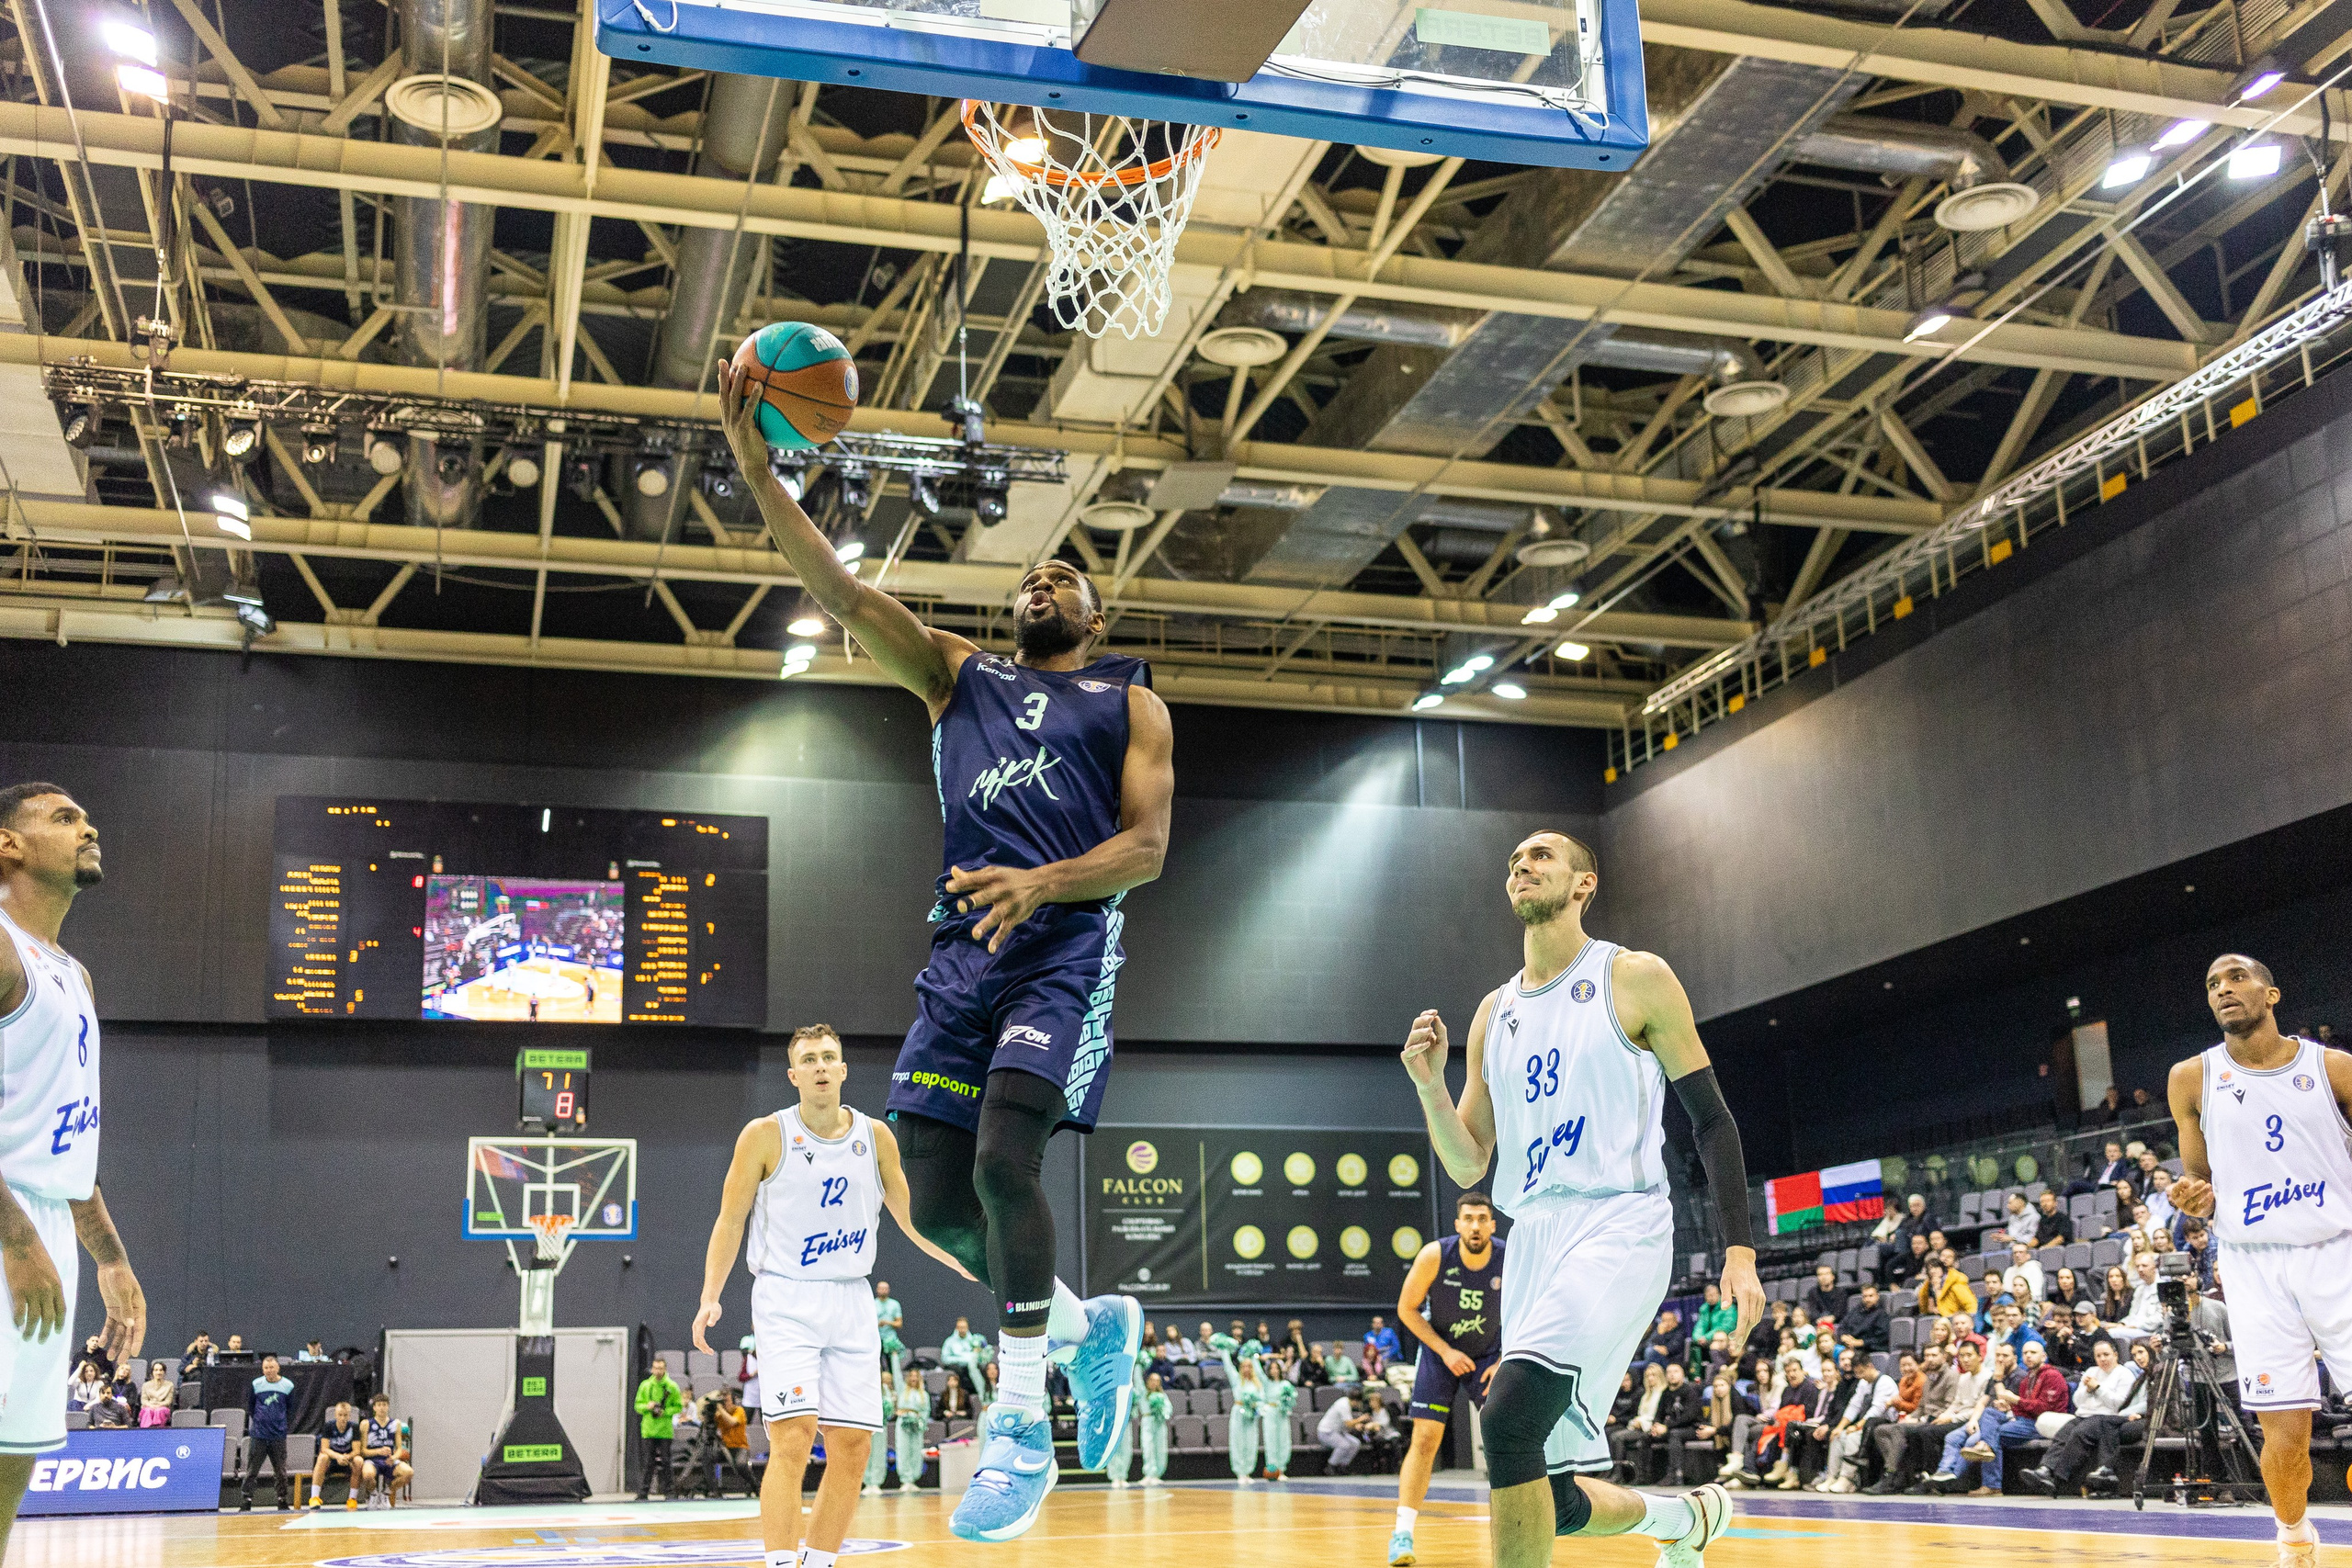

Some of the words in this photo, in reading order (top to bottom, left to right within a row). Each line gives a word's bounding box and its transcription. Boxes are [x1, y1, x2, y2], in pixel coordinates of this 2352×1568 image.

[977, 661, 1017, 682] Kempa
[1015, 692, 1049, 731] 3
[911, 1070, 981, 1099] евроопт
[1525, 1047, 1561, 1103] 33
[556, 1092, 574, 1118] 8
[2265, 1114, 2285, 1153] 3
[820, 1177, 849, 1208] 12
[1102, 1178, 1183, 1195] FALCON
[2243, 1177, 2326, 1226] Enisey
[800, 1228, 867, 1267] Enisey
[1459, 1288, 1485, 1311] 55
[507, 1449, 559, 1459] BETERA
[28, 1457, 171, 1492] ЕРВИС
